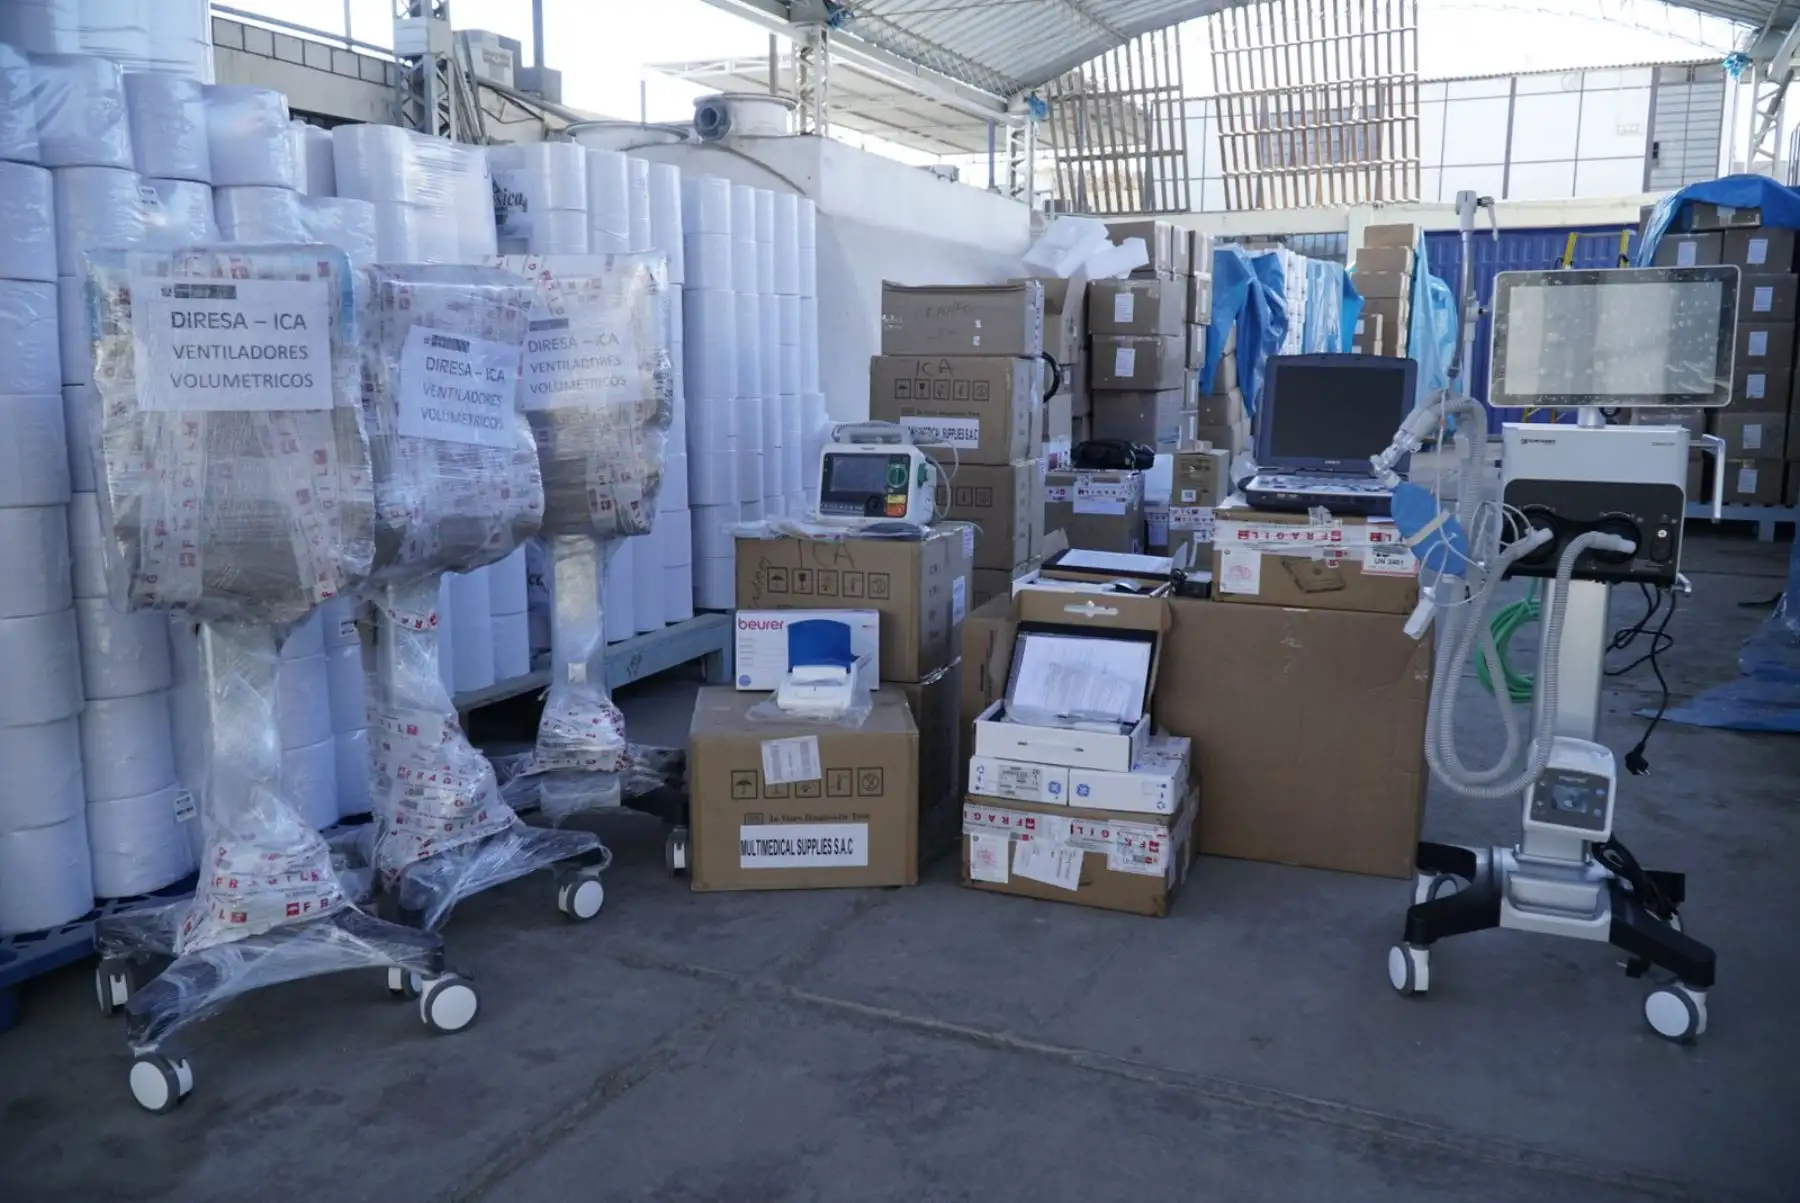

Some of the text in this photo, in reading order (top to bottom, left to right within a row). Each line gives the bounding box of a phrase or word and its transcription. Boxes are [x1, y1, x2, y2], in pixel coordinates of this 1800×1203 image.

[171, 311, 248, 329] DIRESA
[273, 313, 307, 330] ICA
[527, 336, 578, 353] DIRESA
[596, 331, 620, 347] ICA
[172, 344, 309, 360] VENTILADORES
[425, 356, 473, 378] DIRESA
[485, 367, 506, 384] ICA
[529, 353, 622, 373] VENTILADORES
[170, 372, 314, 389] VOLUMETRICOS
[528, 376, 627, 394] VOLUMETRICOS
[422, 383, 504, 407] VENTILADORES
[420, 406, 504, 430] VOLUMETRICOS
[738, 617, 784, 630] beurer
[740, 839, 796, 857] MULTIMEDICAL
[796, 838, 832, 856] SUPPLIES
